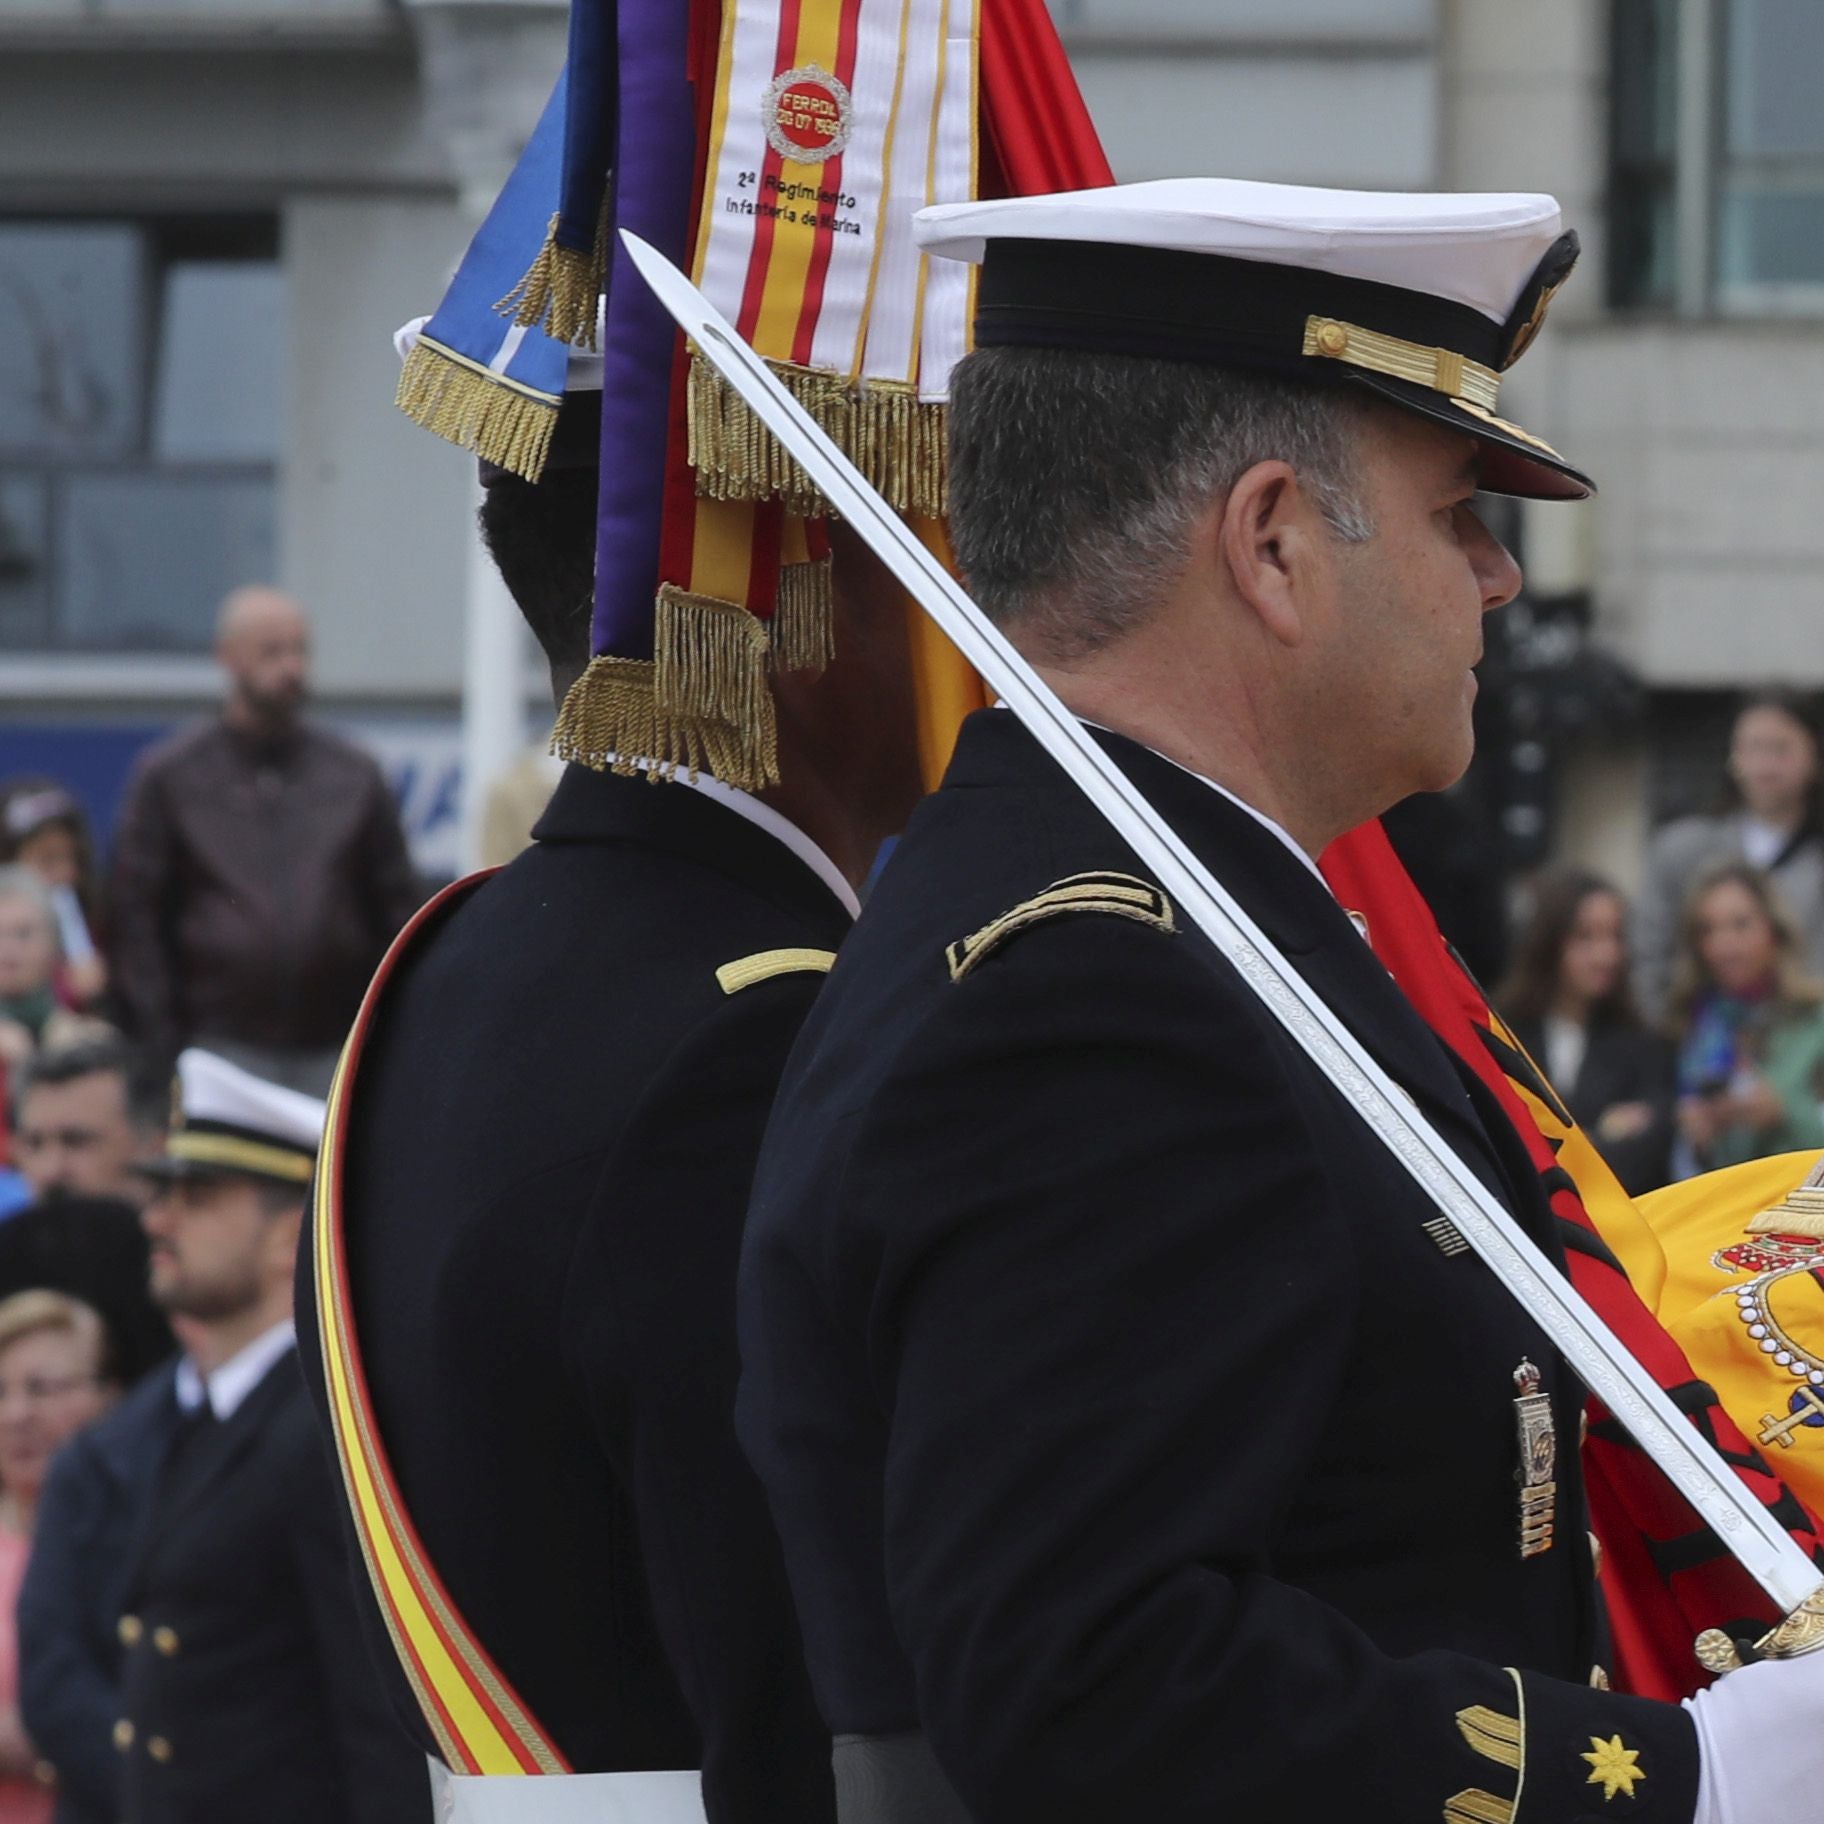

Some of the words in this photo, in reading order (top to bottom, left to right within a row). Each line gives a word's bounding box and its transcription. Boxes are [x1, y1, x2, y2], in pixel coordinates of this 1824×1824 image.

[782, 93, 837, 116] FERROL
[765, 175, 857, 209] Regimiento
[801, 210, 817, 226] de
[821, 216, 862, 236] Marina
